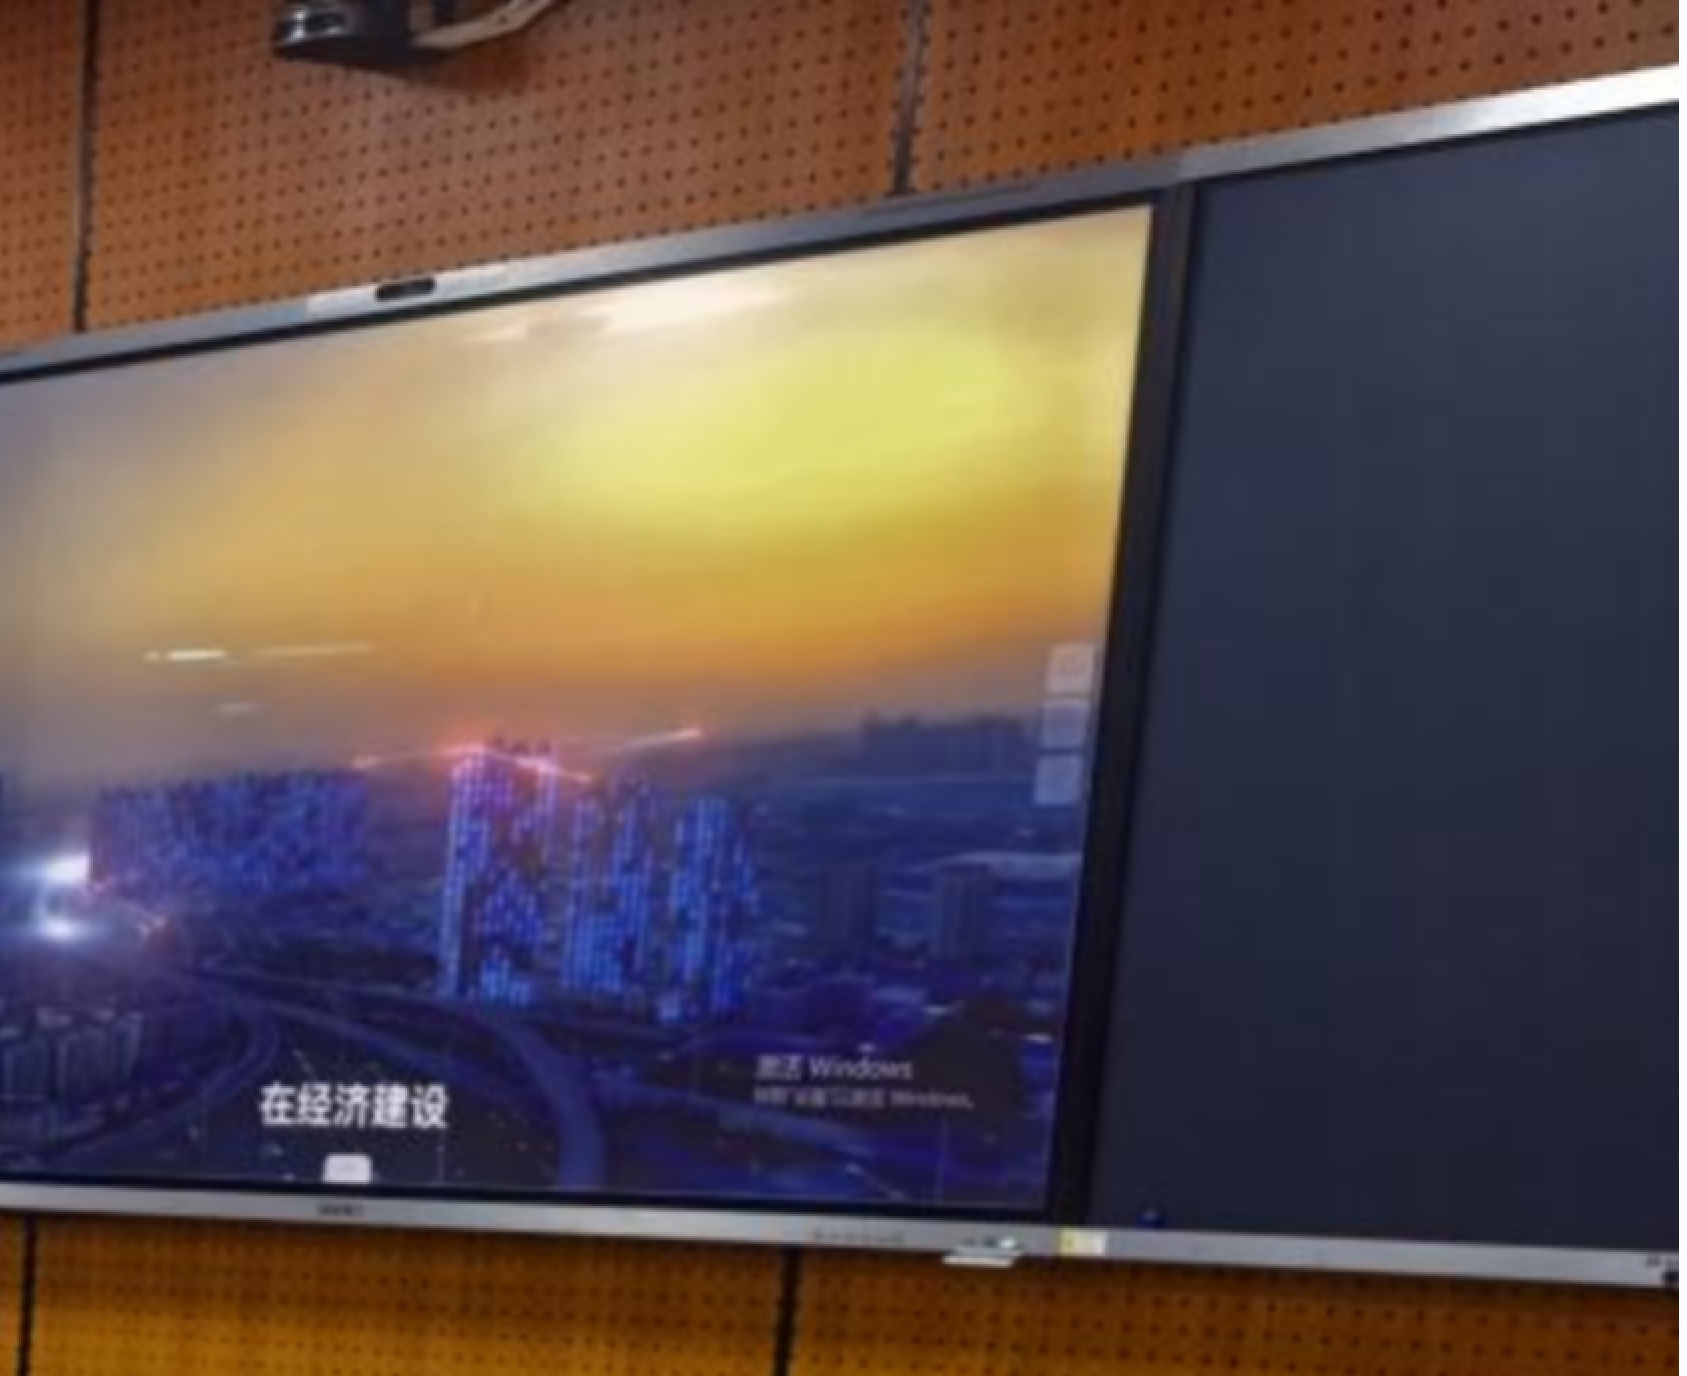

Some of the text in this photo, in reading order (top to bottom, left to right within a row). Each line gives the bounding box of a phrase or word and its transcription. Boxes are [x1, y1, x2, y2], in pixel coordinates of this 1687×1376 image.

[808, 1053, 914, 1082] Windows
[259, 1080, 450, 1130] 在经济建设
